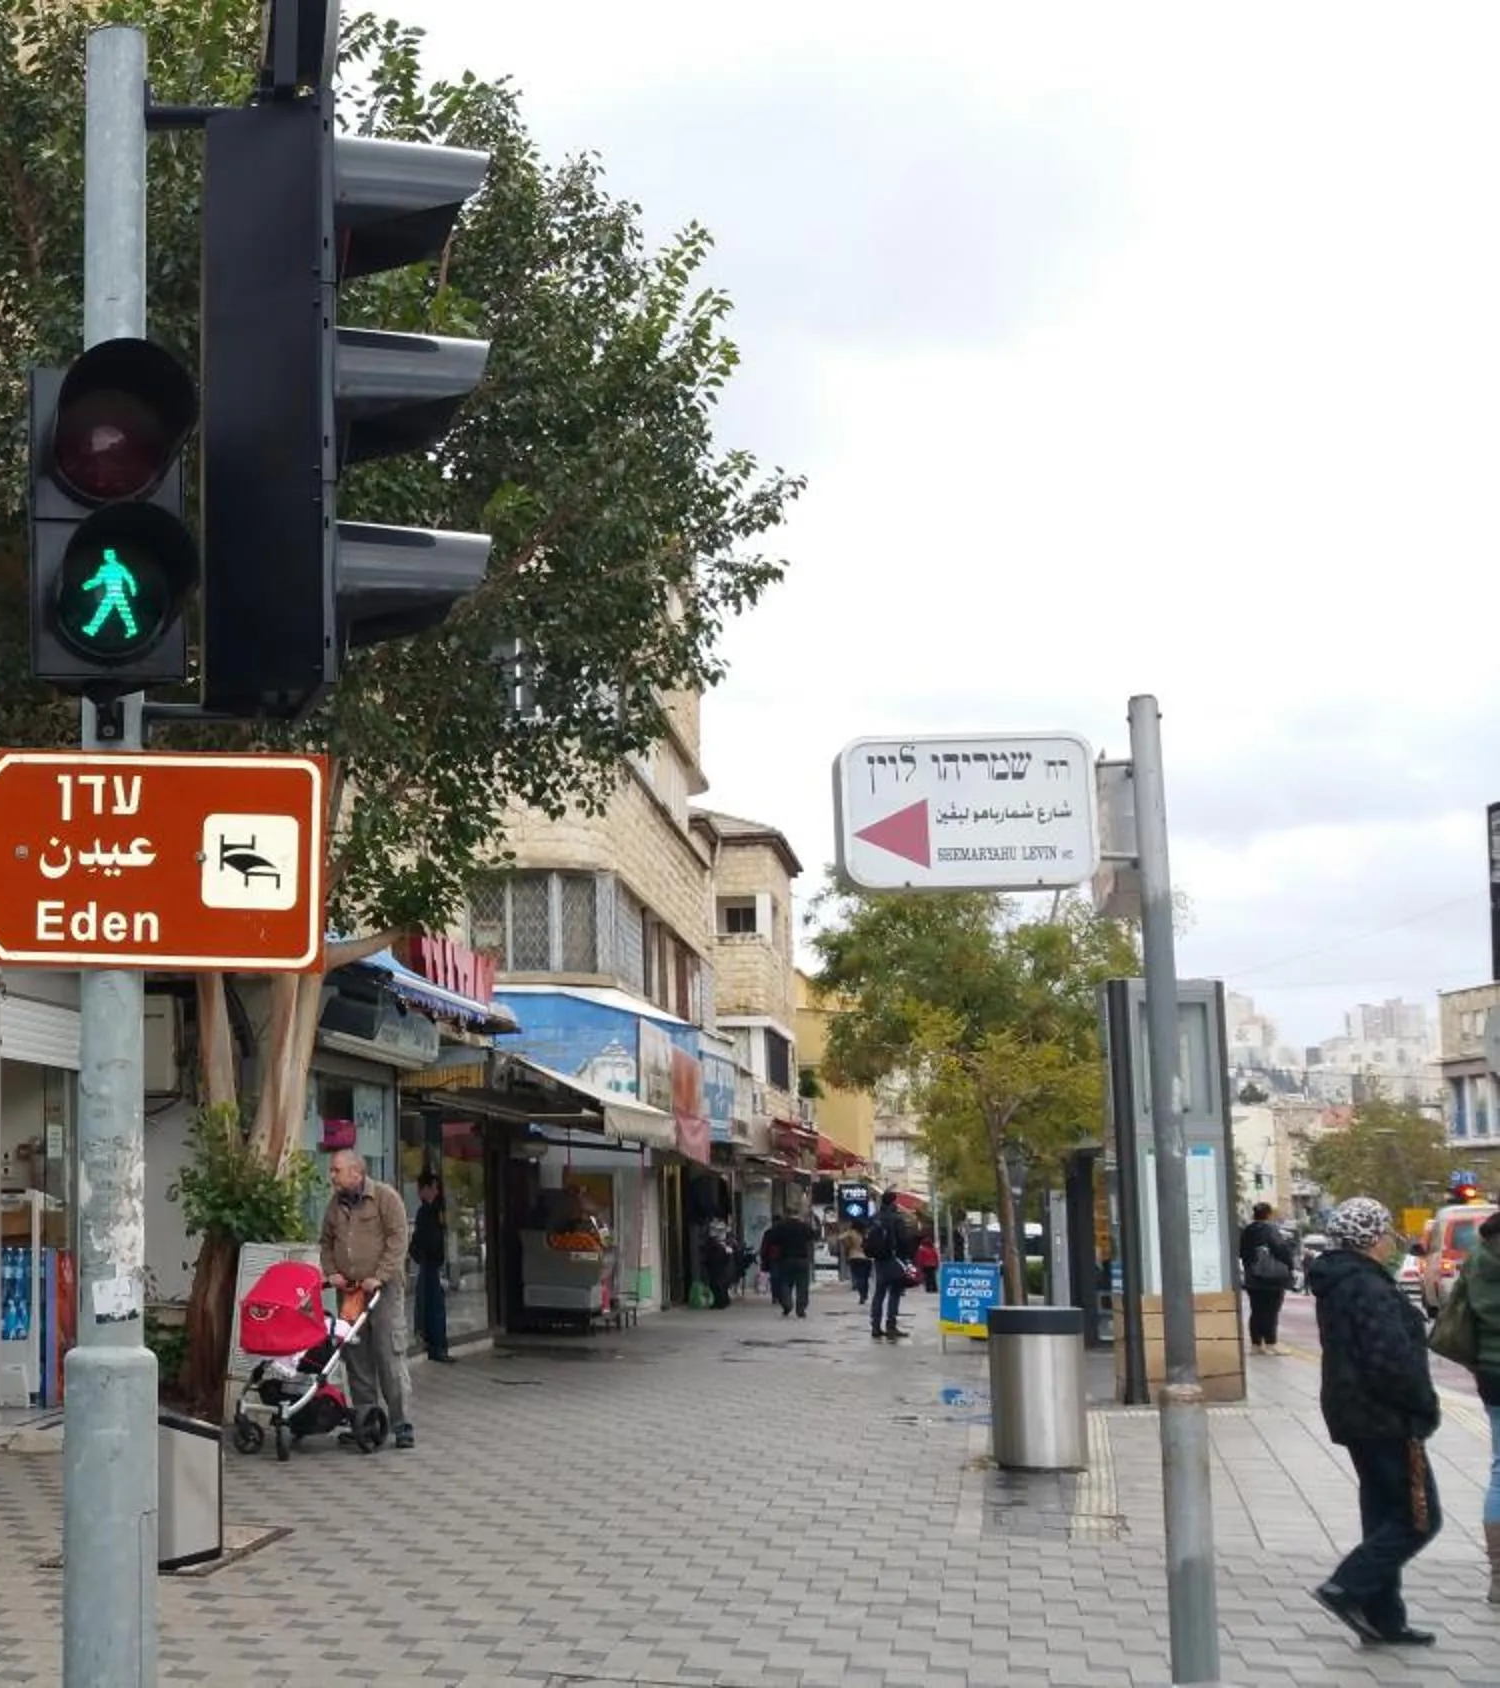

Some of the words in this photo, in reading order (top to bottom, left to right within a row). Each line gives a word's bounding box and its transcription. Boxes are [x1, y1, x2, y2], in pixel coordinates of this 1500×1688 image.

[867, 744, 917, 795] לוין
[930, 751, 1033, 781] שמריהו
[58, 774, 143, 821] עדן
[1021, 845, 1058, 861] LEVIN
[36, 900, 160, 942] Eden
